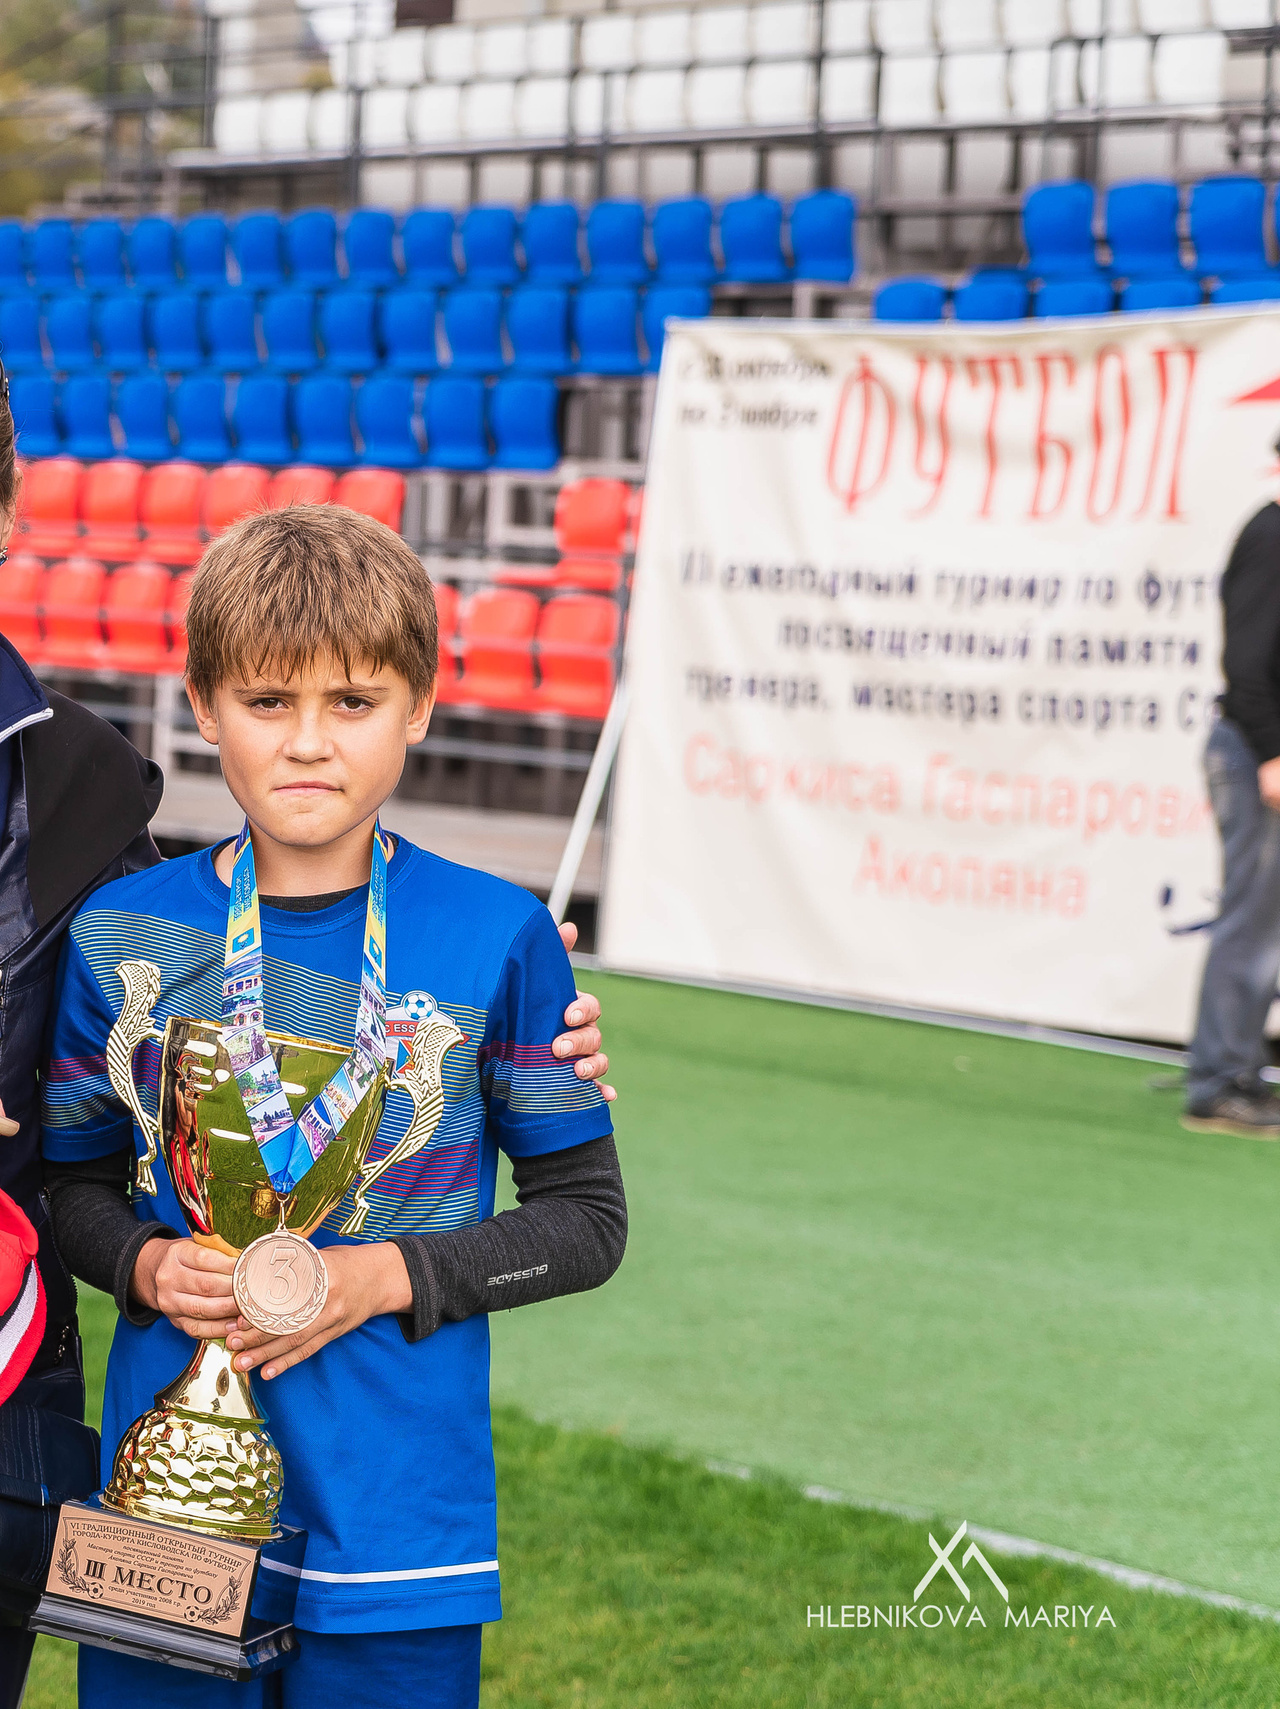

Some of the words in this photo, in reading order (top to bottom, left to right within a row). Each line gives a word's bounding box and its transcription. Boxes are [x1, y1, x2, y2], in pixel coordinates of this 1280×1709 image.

[824, 345, 1196, 523] ФУТБОЛ
[932, 571, 1061, 616] турнир
[1046, 634, 1201, 668] памяти
[852, 680, 1004, 728] мастера
[1017, 690, 1160, 736] спорта
[683, 732, 901, 812] Саркиса
[855, 834, 1089, 917] Акопяна
[265, 1246, 299, 1306] 3
[486, 1263, 549, 1287] GLISSADE
[70, 1522, 80, 1530] VI
[81, 1522, 156, 1541] ТРАДИЦИОННЫЙ
[156, 1535, 207, 1555] ОТКРЫТЫЙ
[208, 1550, 242, 1568] ТУРНИР
[72, 1530, 136, 1544] ГОРОДА-КУРОРТА
[136, 1539, 190, 1559] КИСЛОВОДСКА
[191, 1553, 203, 1561] ПО
[204, 1557, 237, 1573] ФУТБОЛУ
[86, 1542, 114, 1554] Мастера
[114, 1549, 136, 1560] спорта
[136, 1554, 155, 1563] СССР
[83, 1558, 108, 1582] III
[111, 1565, 213, 1605] МЕСТО
[131, 1598, 146, 1606] 2019
